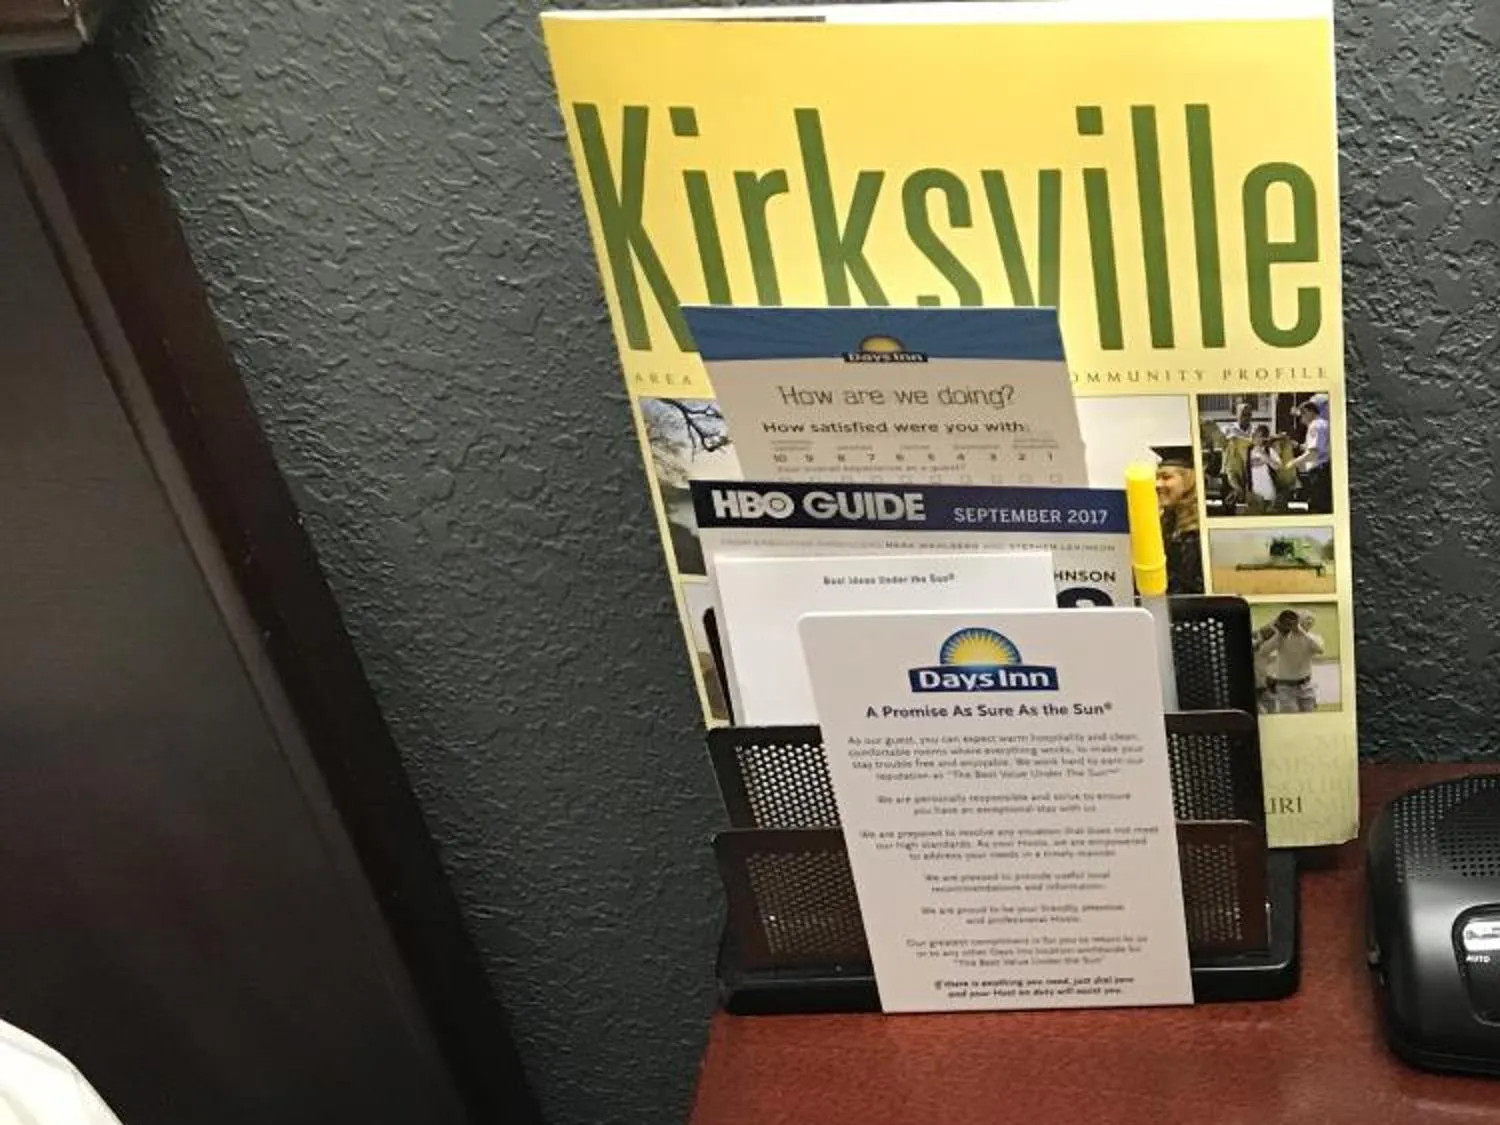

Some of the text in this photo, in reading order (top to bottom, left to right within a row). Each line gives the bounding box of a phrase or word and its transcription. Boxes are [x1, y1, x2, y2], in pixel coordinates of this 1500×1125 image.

[572, 103, 1323, 352] Kirksville
[634, 371, 692, 385] AREA
[1074, 366, 1329, 383] MMUNITY PROFILE
[778, 384, 1016, 409] How are we doing?
[762, 421, 805, 433] How
[810, 421, 888, 433] satisfied
[892, 423, 940, 433] were
[945, 423, 979, 435] you
[713, 489, 926, 521] HBO GUIDE
[953, 506, 1109, 524] SEPTEMBER 2017
[1054, 570, 1116, 582] HNSON
[918, 670, 1049, 691] Days Inn
[866, 705, 878, 719] A
[882, 704, 949, 719] Promise
[952, 704, 972, 718] As
[977, 703, 1014, 718] Sure
[1018, 703, 1038, 717] As
[1042, 702, 1068, 717] the
[1466, 954, 1491, 963] AUTO
